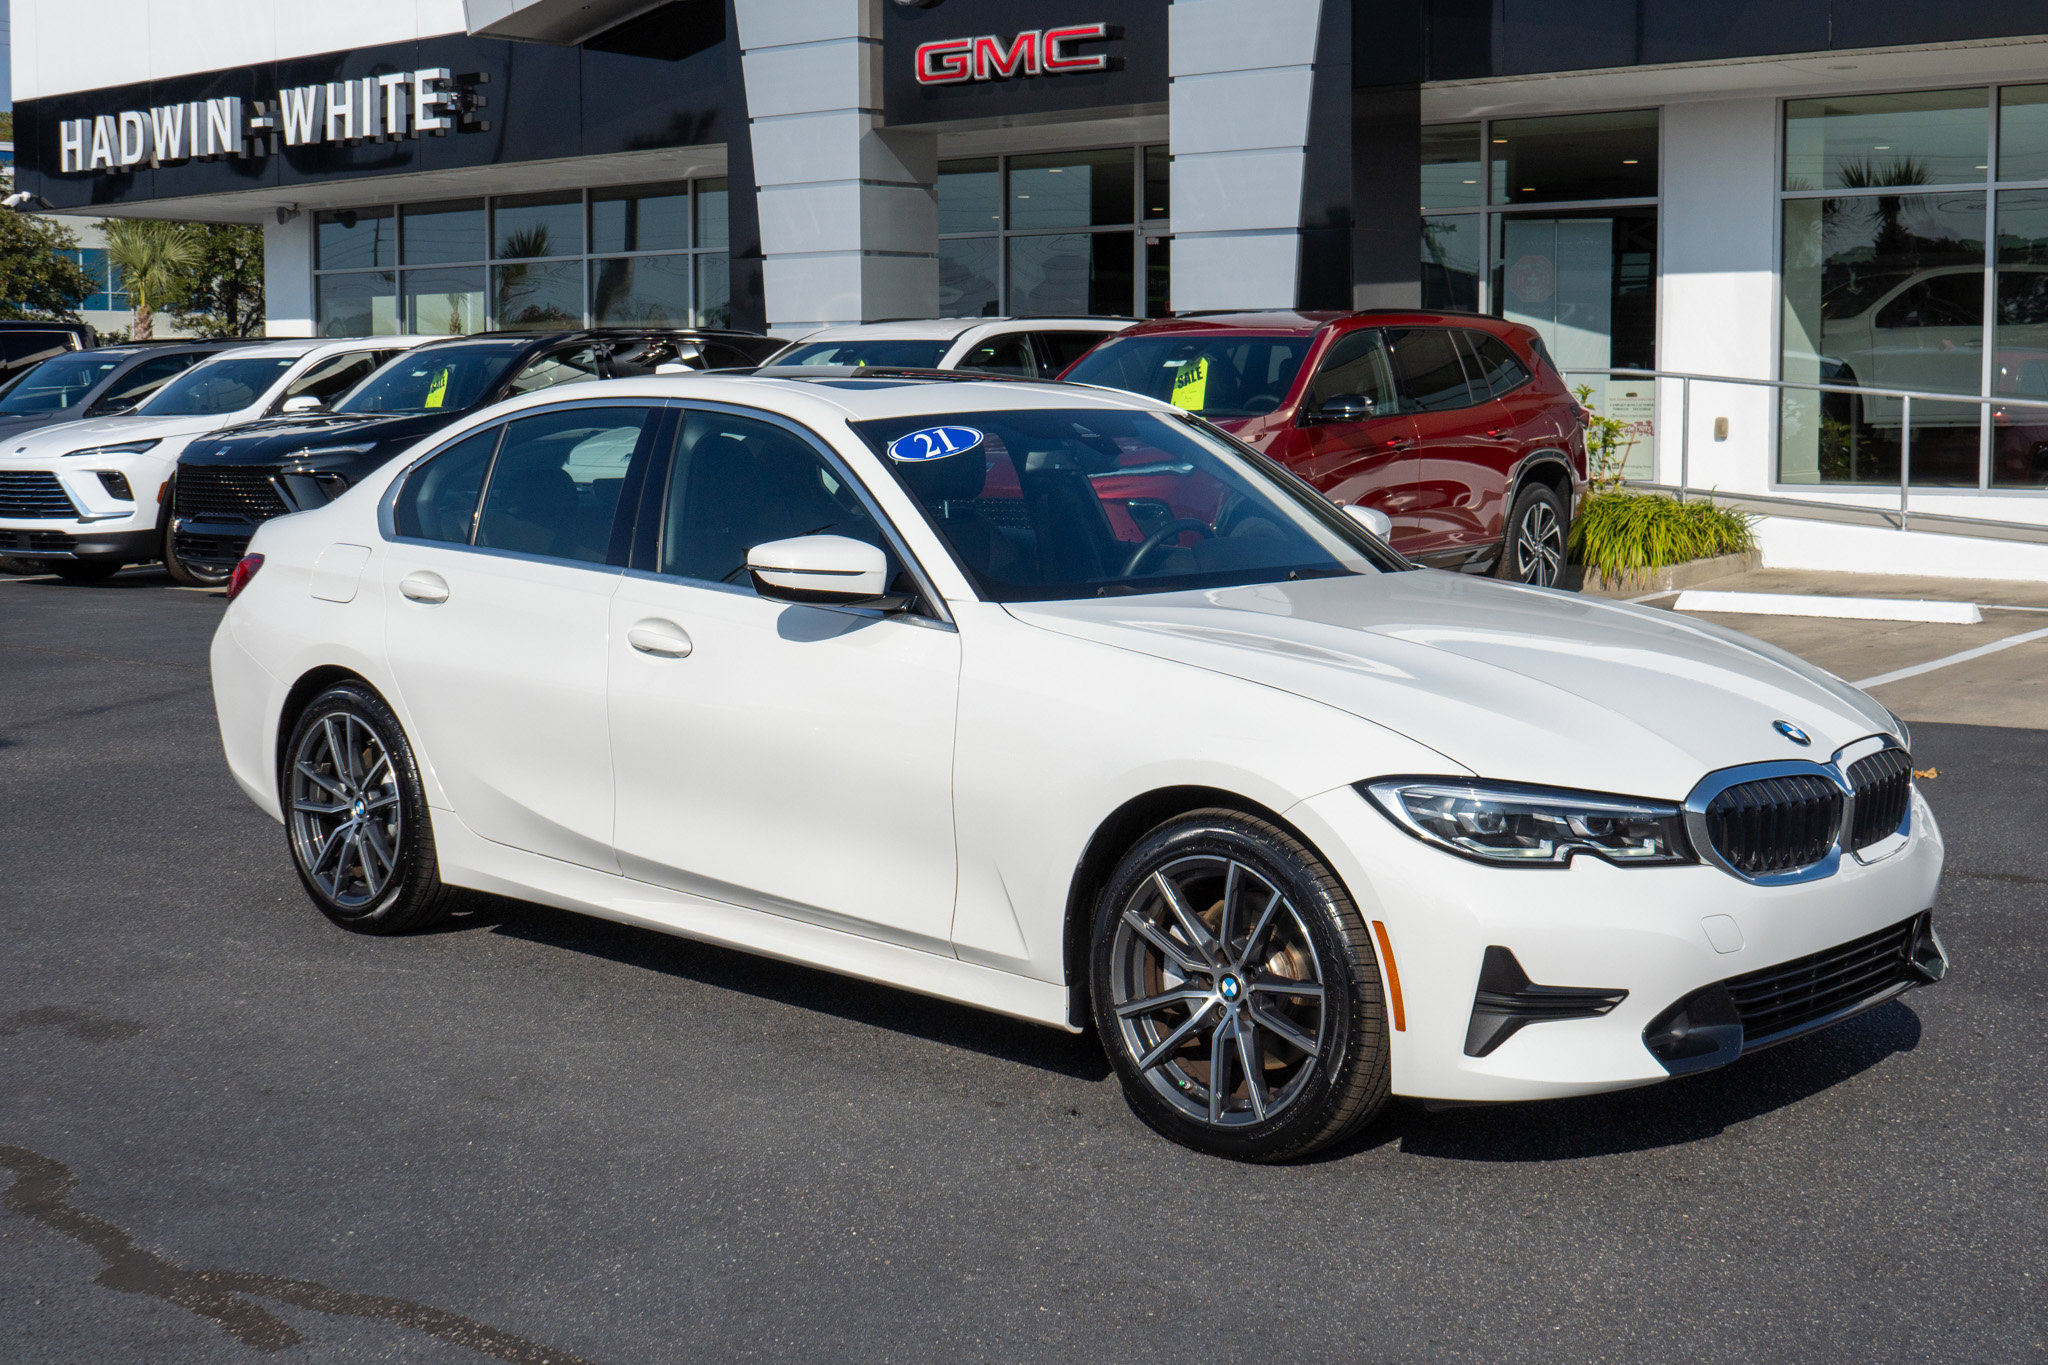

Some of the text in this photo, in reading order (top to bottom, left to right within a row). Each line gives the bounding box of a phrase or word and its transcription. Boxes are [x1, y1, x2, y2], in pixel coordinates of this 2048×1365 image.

[915, 22, 1107, 85] GMC
[1177, 366, 1204, 389] SALE
[913, 428, 960, 458] 21
